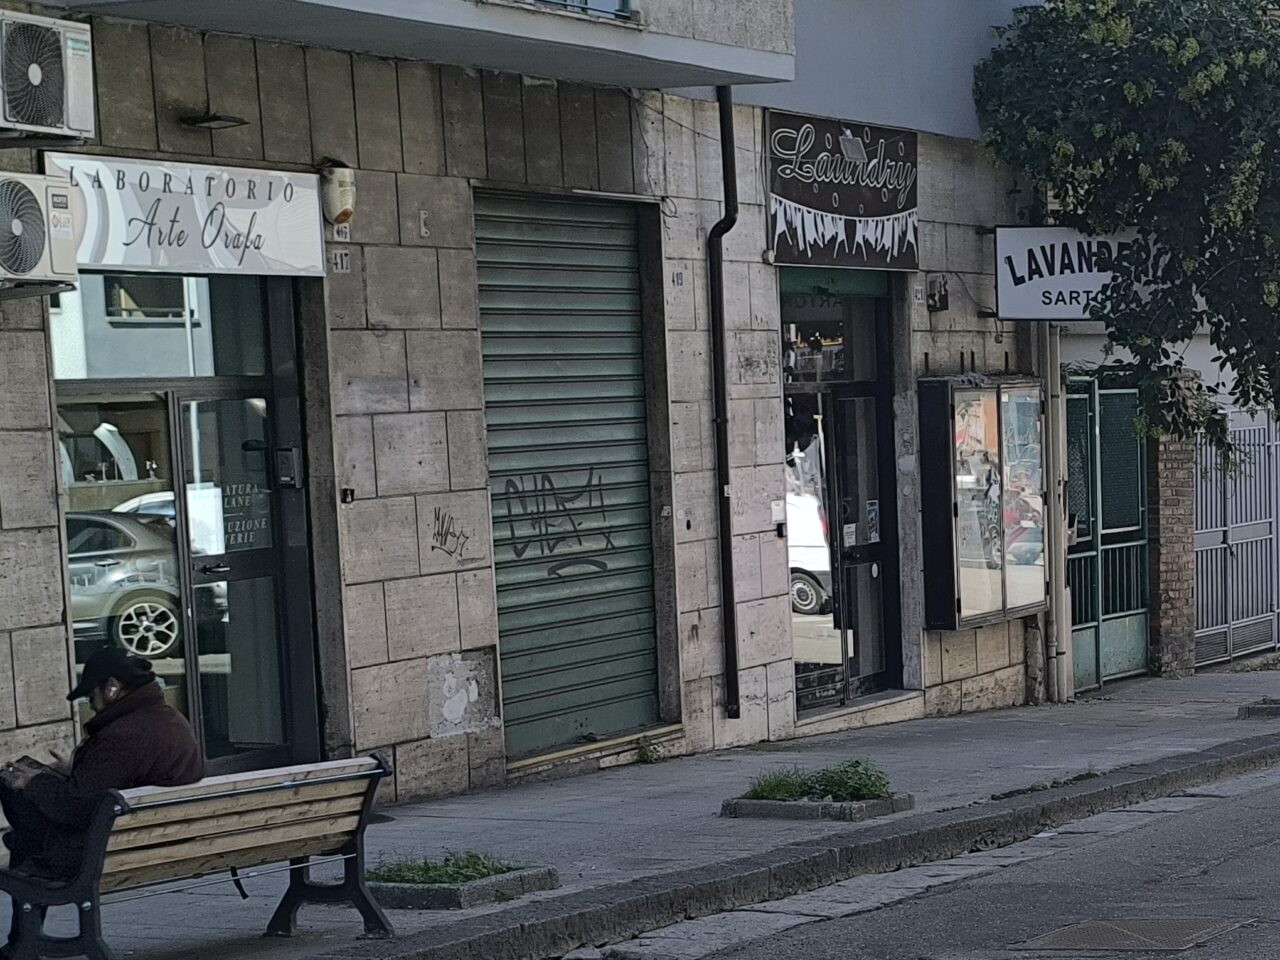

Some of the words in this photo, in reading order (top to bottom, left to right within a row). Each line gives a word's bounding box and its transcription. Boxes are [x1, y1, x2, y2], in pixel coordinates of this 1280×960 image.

[771, 124, 916, 209] Laundry
[69, 166, 294, 203] LABORATORIO
[122, 198, 189, 248] Arte
[201, 202, 265, 266] Orafa
[224, 483, 259, 496] ATURA
[224, 495, 252, 508] LANE
[226, 518, 267, 532] UZIONE
